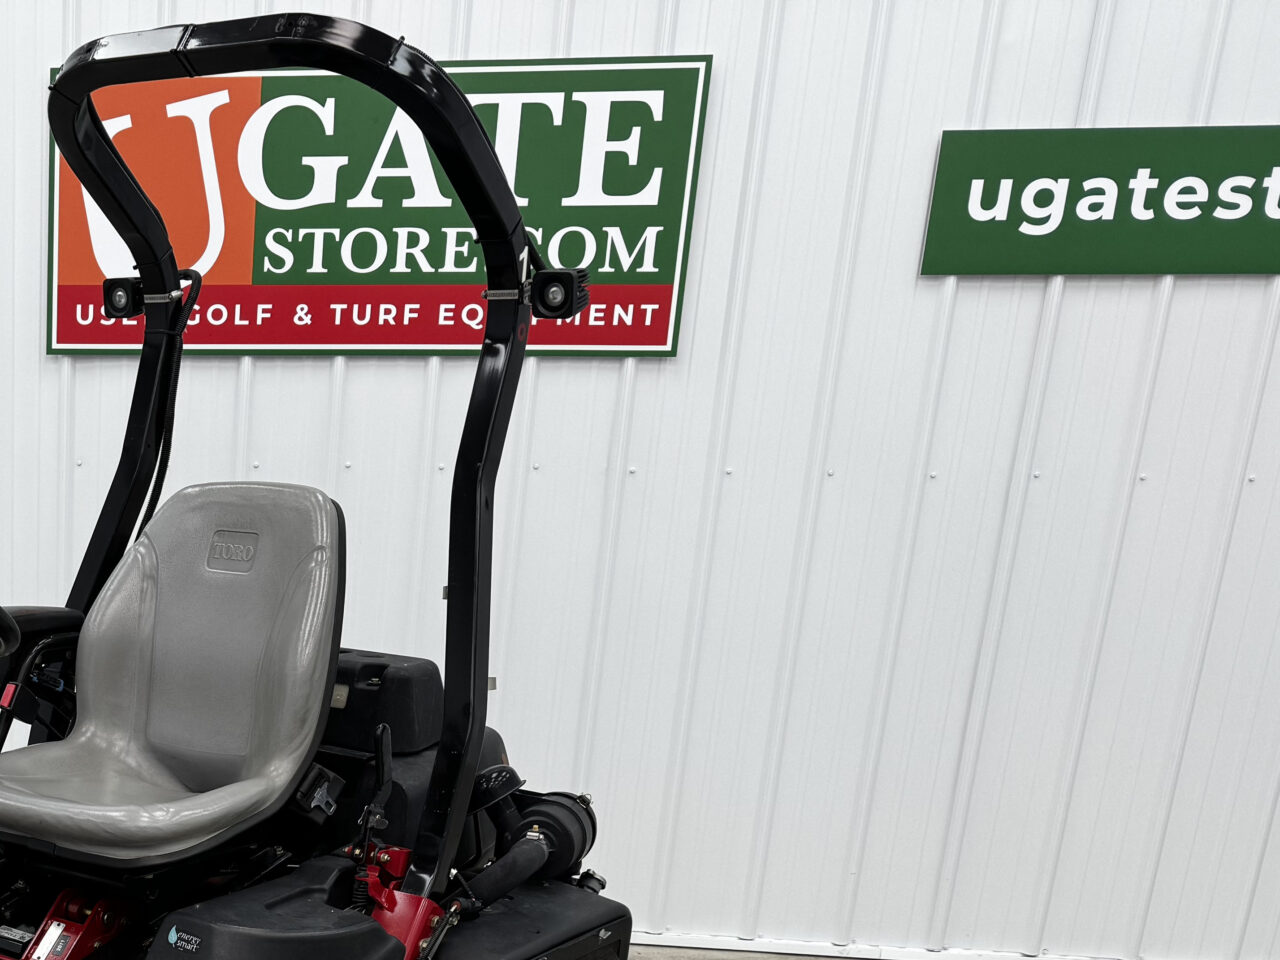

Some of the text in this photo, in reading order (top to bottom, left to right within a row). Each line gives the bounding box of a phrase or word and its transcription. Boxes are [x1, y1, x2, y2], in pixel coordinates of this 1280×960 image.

[968, 166, 1280, 236] ugatest
[293, 303, 312, 326] &
[329, 303, 421, 326] TURF
[214, 542, 254, 561] TORO
[176, 940, 198, 952] smart
[177, 932, 202, 945] energy
